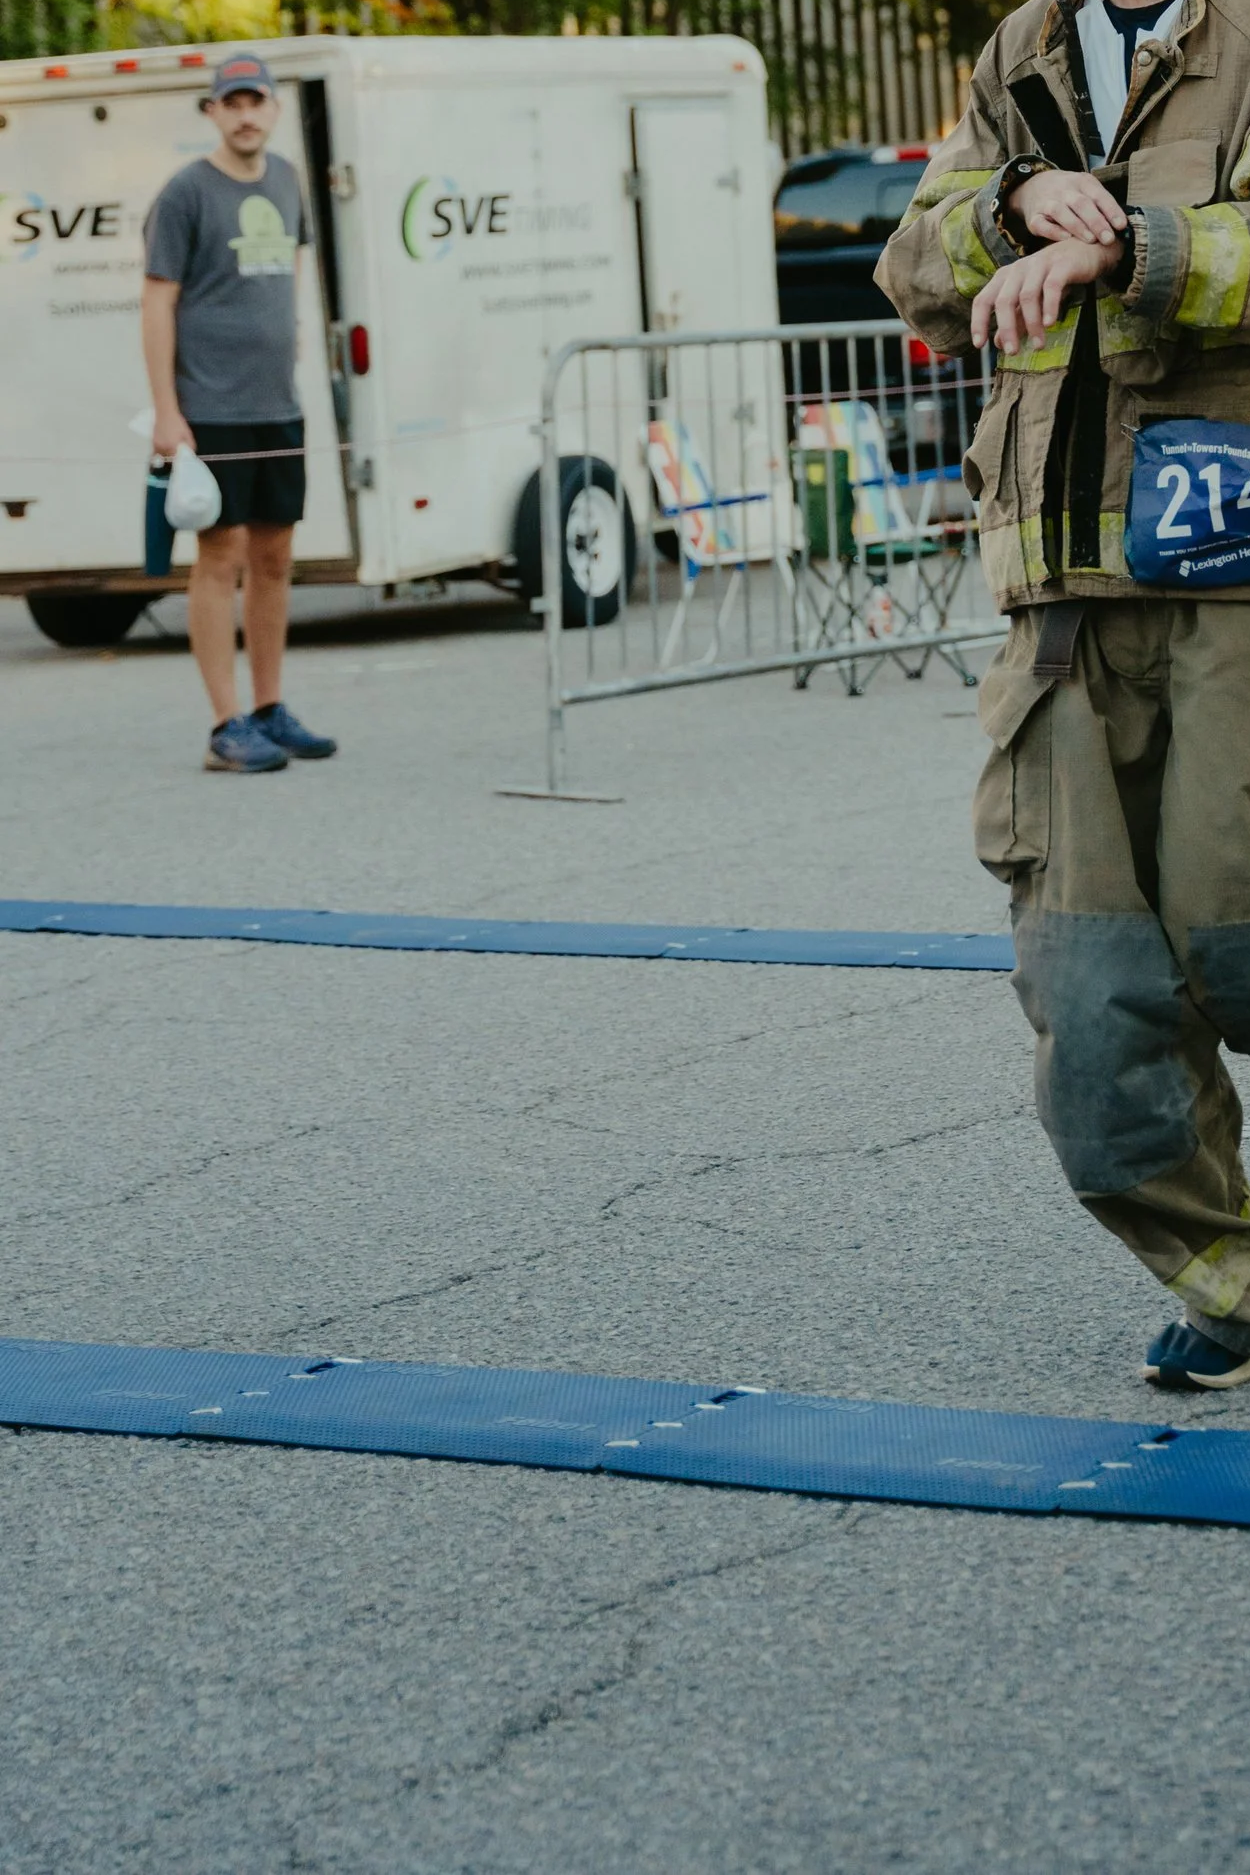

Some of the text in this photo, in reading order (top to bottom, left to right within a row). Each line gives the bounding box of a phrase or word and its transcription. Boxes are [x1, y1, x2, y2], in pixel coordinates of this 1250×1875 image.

[12, 202, 122, 243] SVE
[430, 193, 511, 239] SVE
[1161, 443, 1187, 455] Tunnel
[1192, 442, 1223, 455] Towers
[1191, 552, 1238, 572] Lexington
